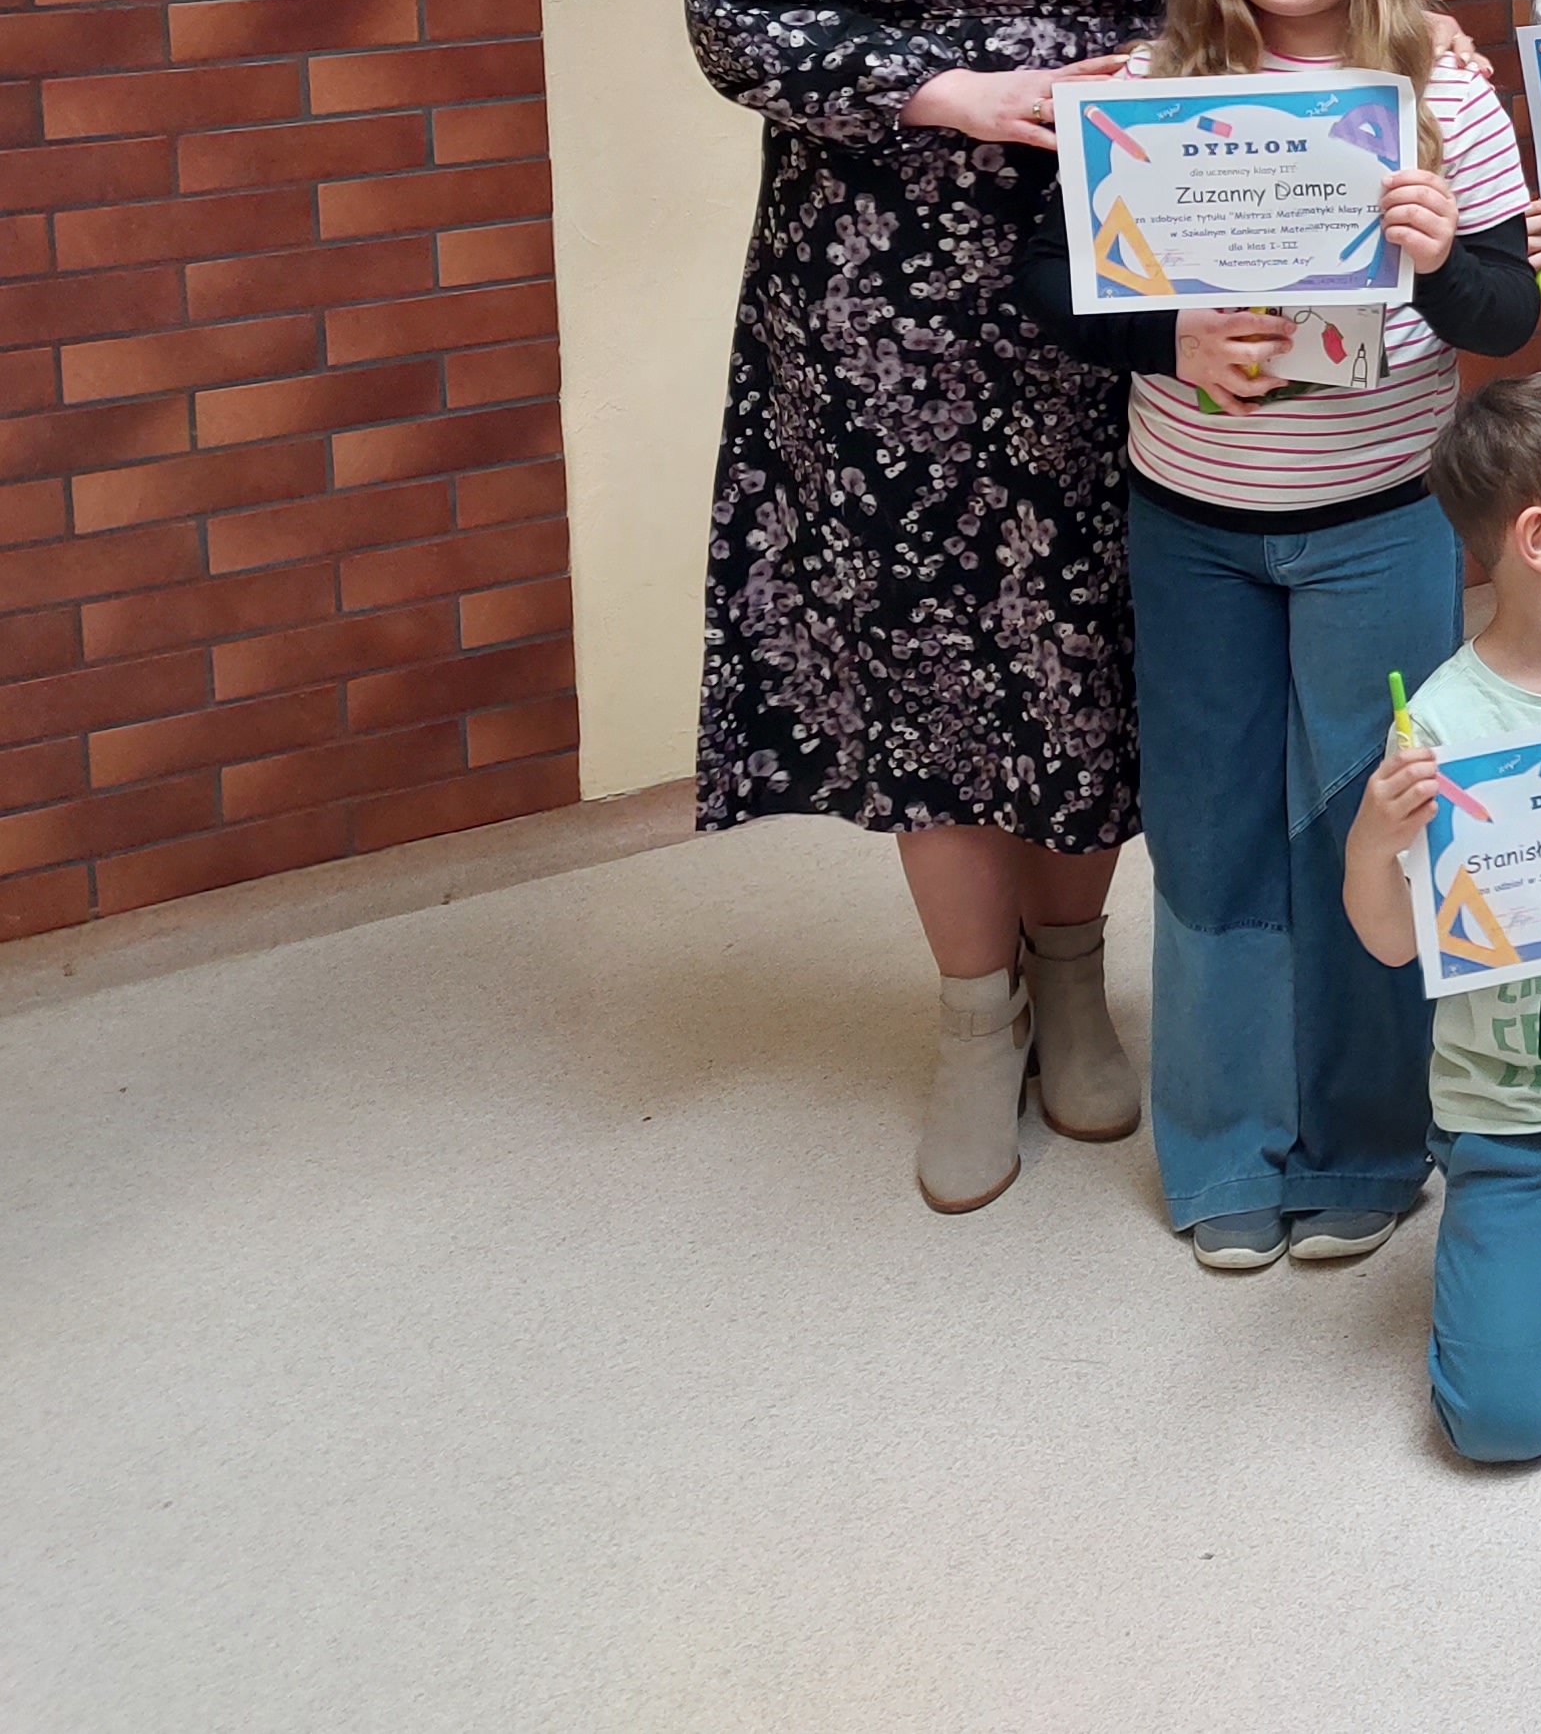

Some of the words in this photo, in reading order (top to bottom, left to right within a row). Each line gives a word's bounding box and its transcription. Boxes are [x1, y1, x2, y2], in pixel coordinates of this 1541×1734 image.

[1182, 140, 1309, 157] DYPLOM
[1253, 166, 1276, 176] klasy
[1176, 187, 1266, 206] Zuzanny
[1150, 214, 1192, 224] zdobycie
[1197, 212, 1226, 224] tytułu
[1339, 205, 1362, 215] klasy
[1228, 243, 1243, 252] dla
[1247, 243, 1266, 251] klas
[1270, 241, 1298, 250] I-III
